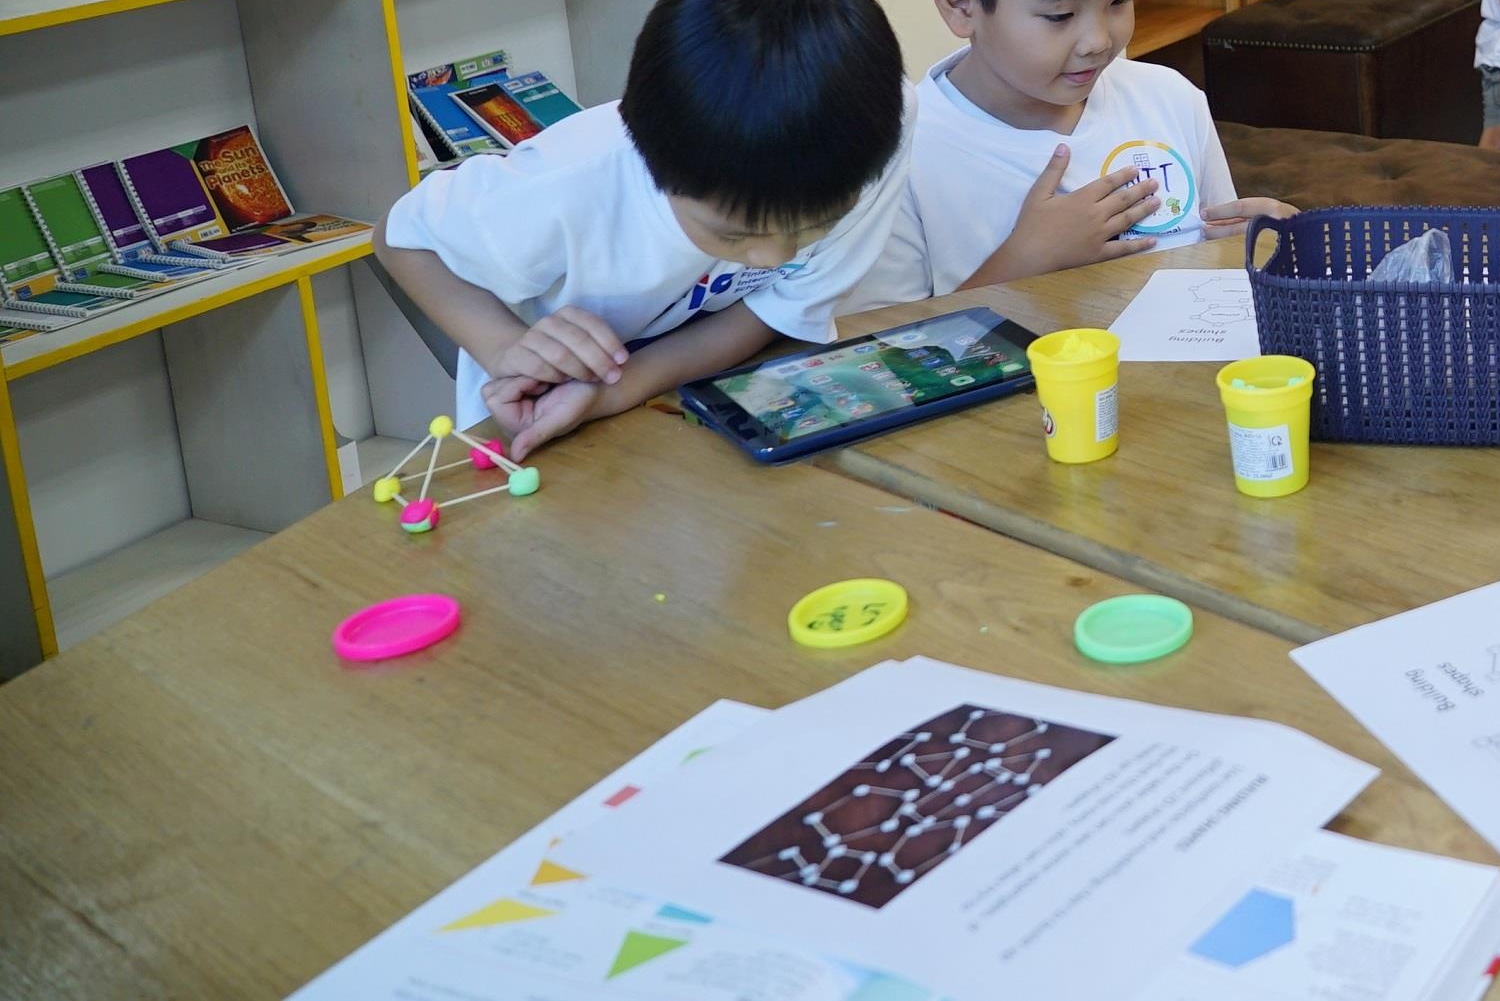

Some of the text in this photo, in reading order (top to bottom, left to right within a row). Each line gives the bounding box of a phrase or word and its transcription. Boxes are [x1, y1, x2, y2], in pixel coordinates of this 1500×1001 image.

[199, 146, 257, 171] The Sun
[205, 163, 266, 190] Planets
[1168, 335, 1225, 343] Building
[1404, 668, 1456, 711] Building
[1438, 661, 1485, 696] shapes
